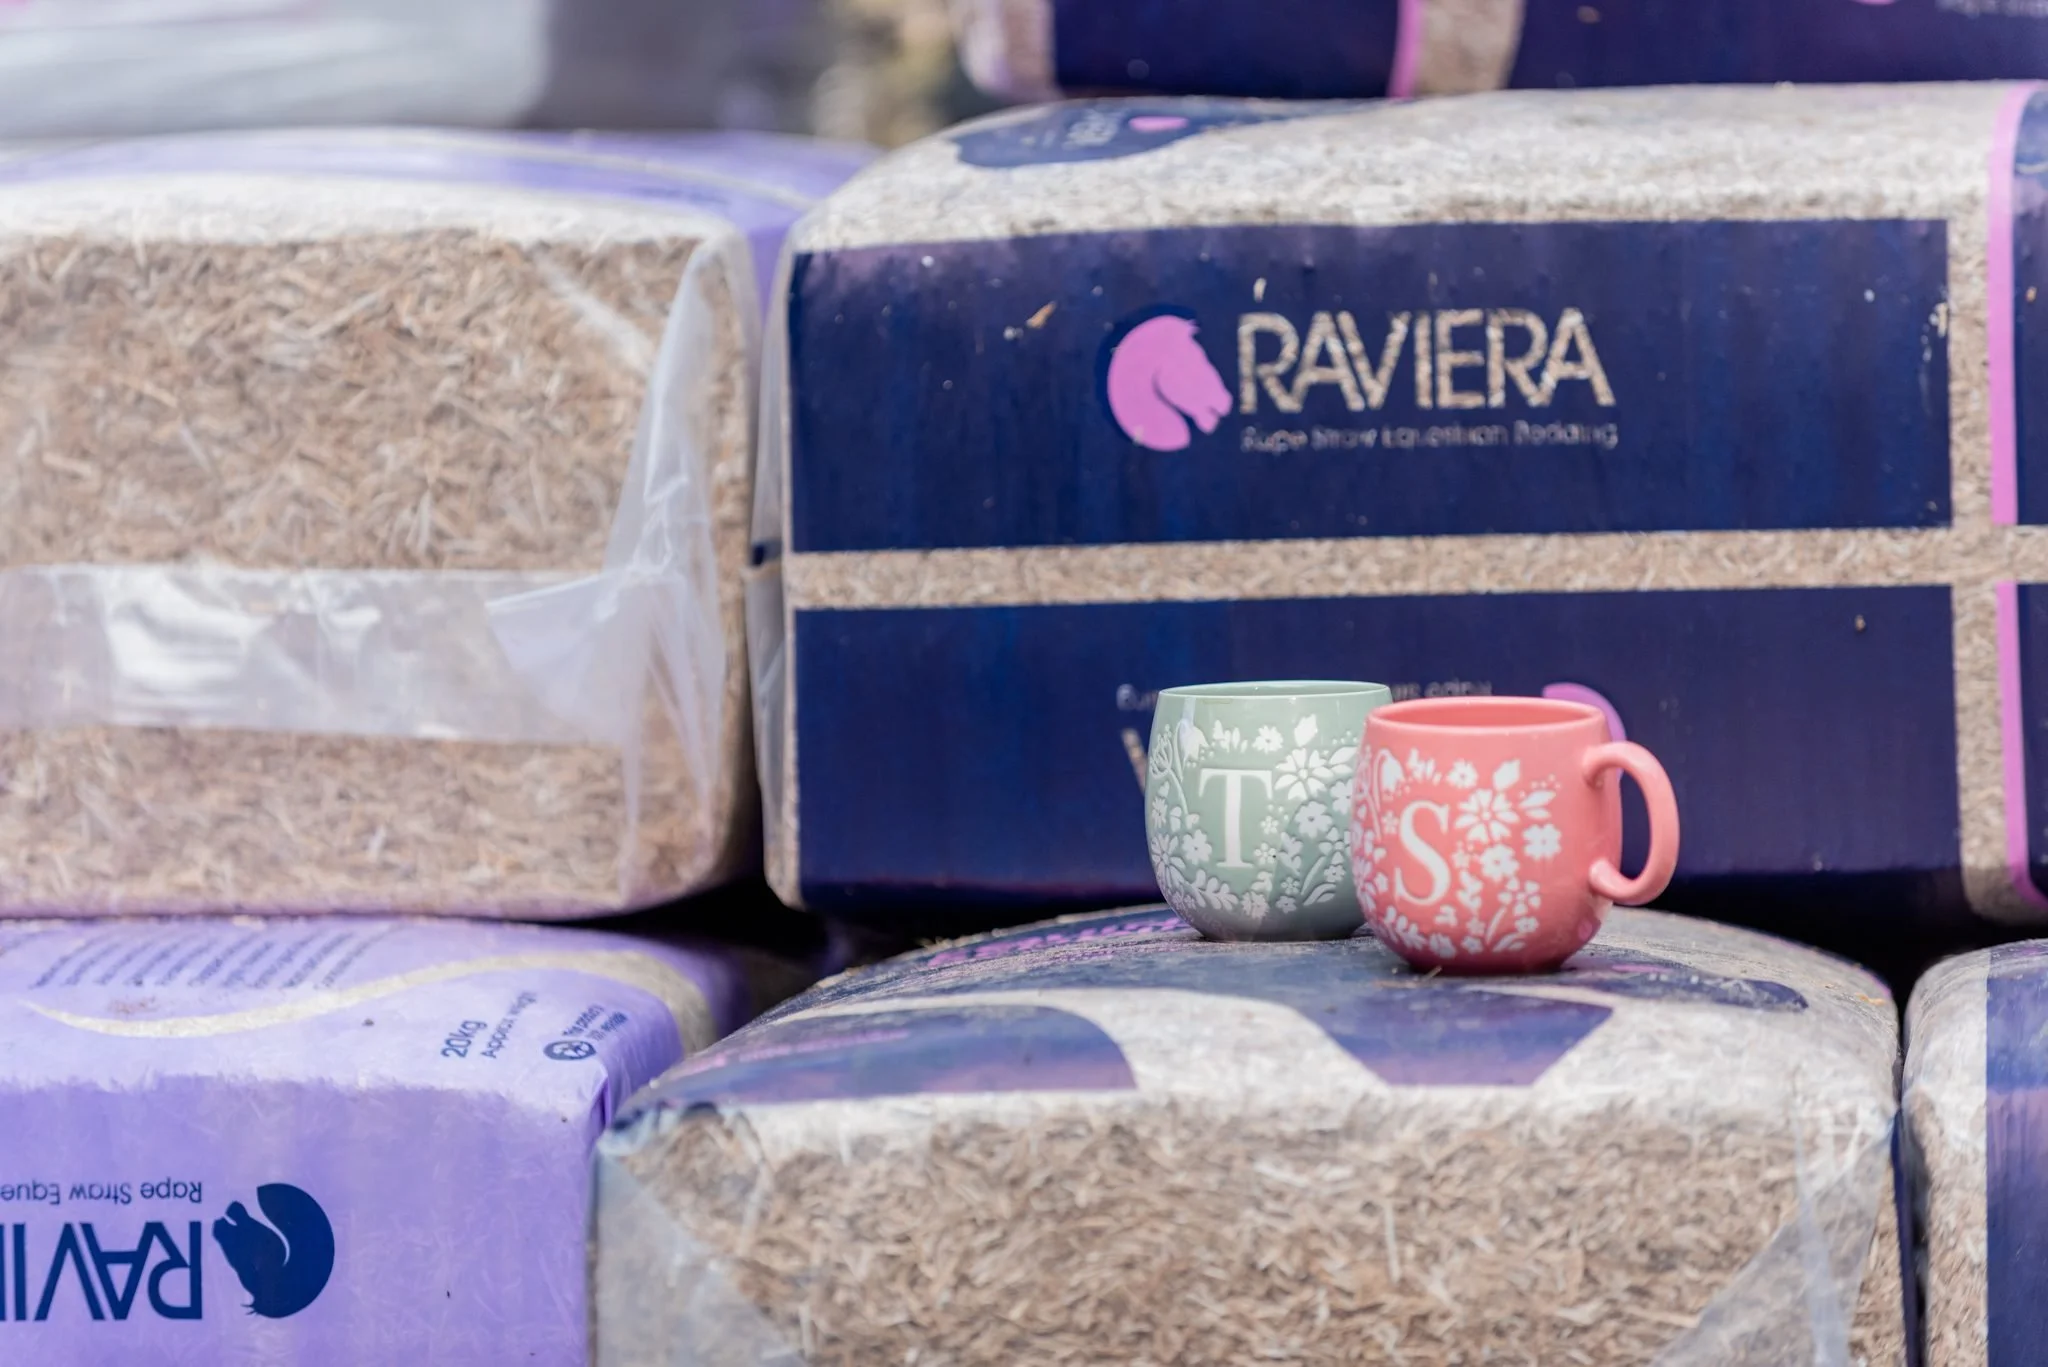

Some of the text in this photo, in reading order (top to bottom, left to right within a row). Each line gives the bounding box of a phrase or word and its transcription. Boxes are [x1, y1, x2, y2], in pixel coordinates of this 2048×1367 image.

[1237, 308, 1616, 414] RAVIERA
[1199, 767, 1273, 868] T
[1395, 799, 1451, 906] S
[440, 1020, 488, 1059] 20kg
[0, 1177, 203, 1206] Rape Straw Eque
